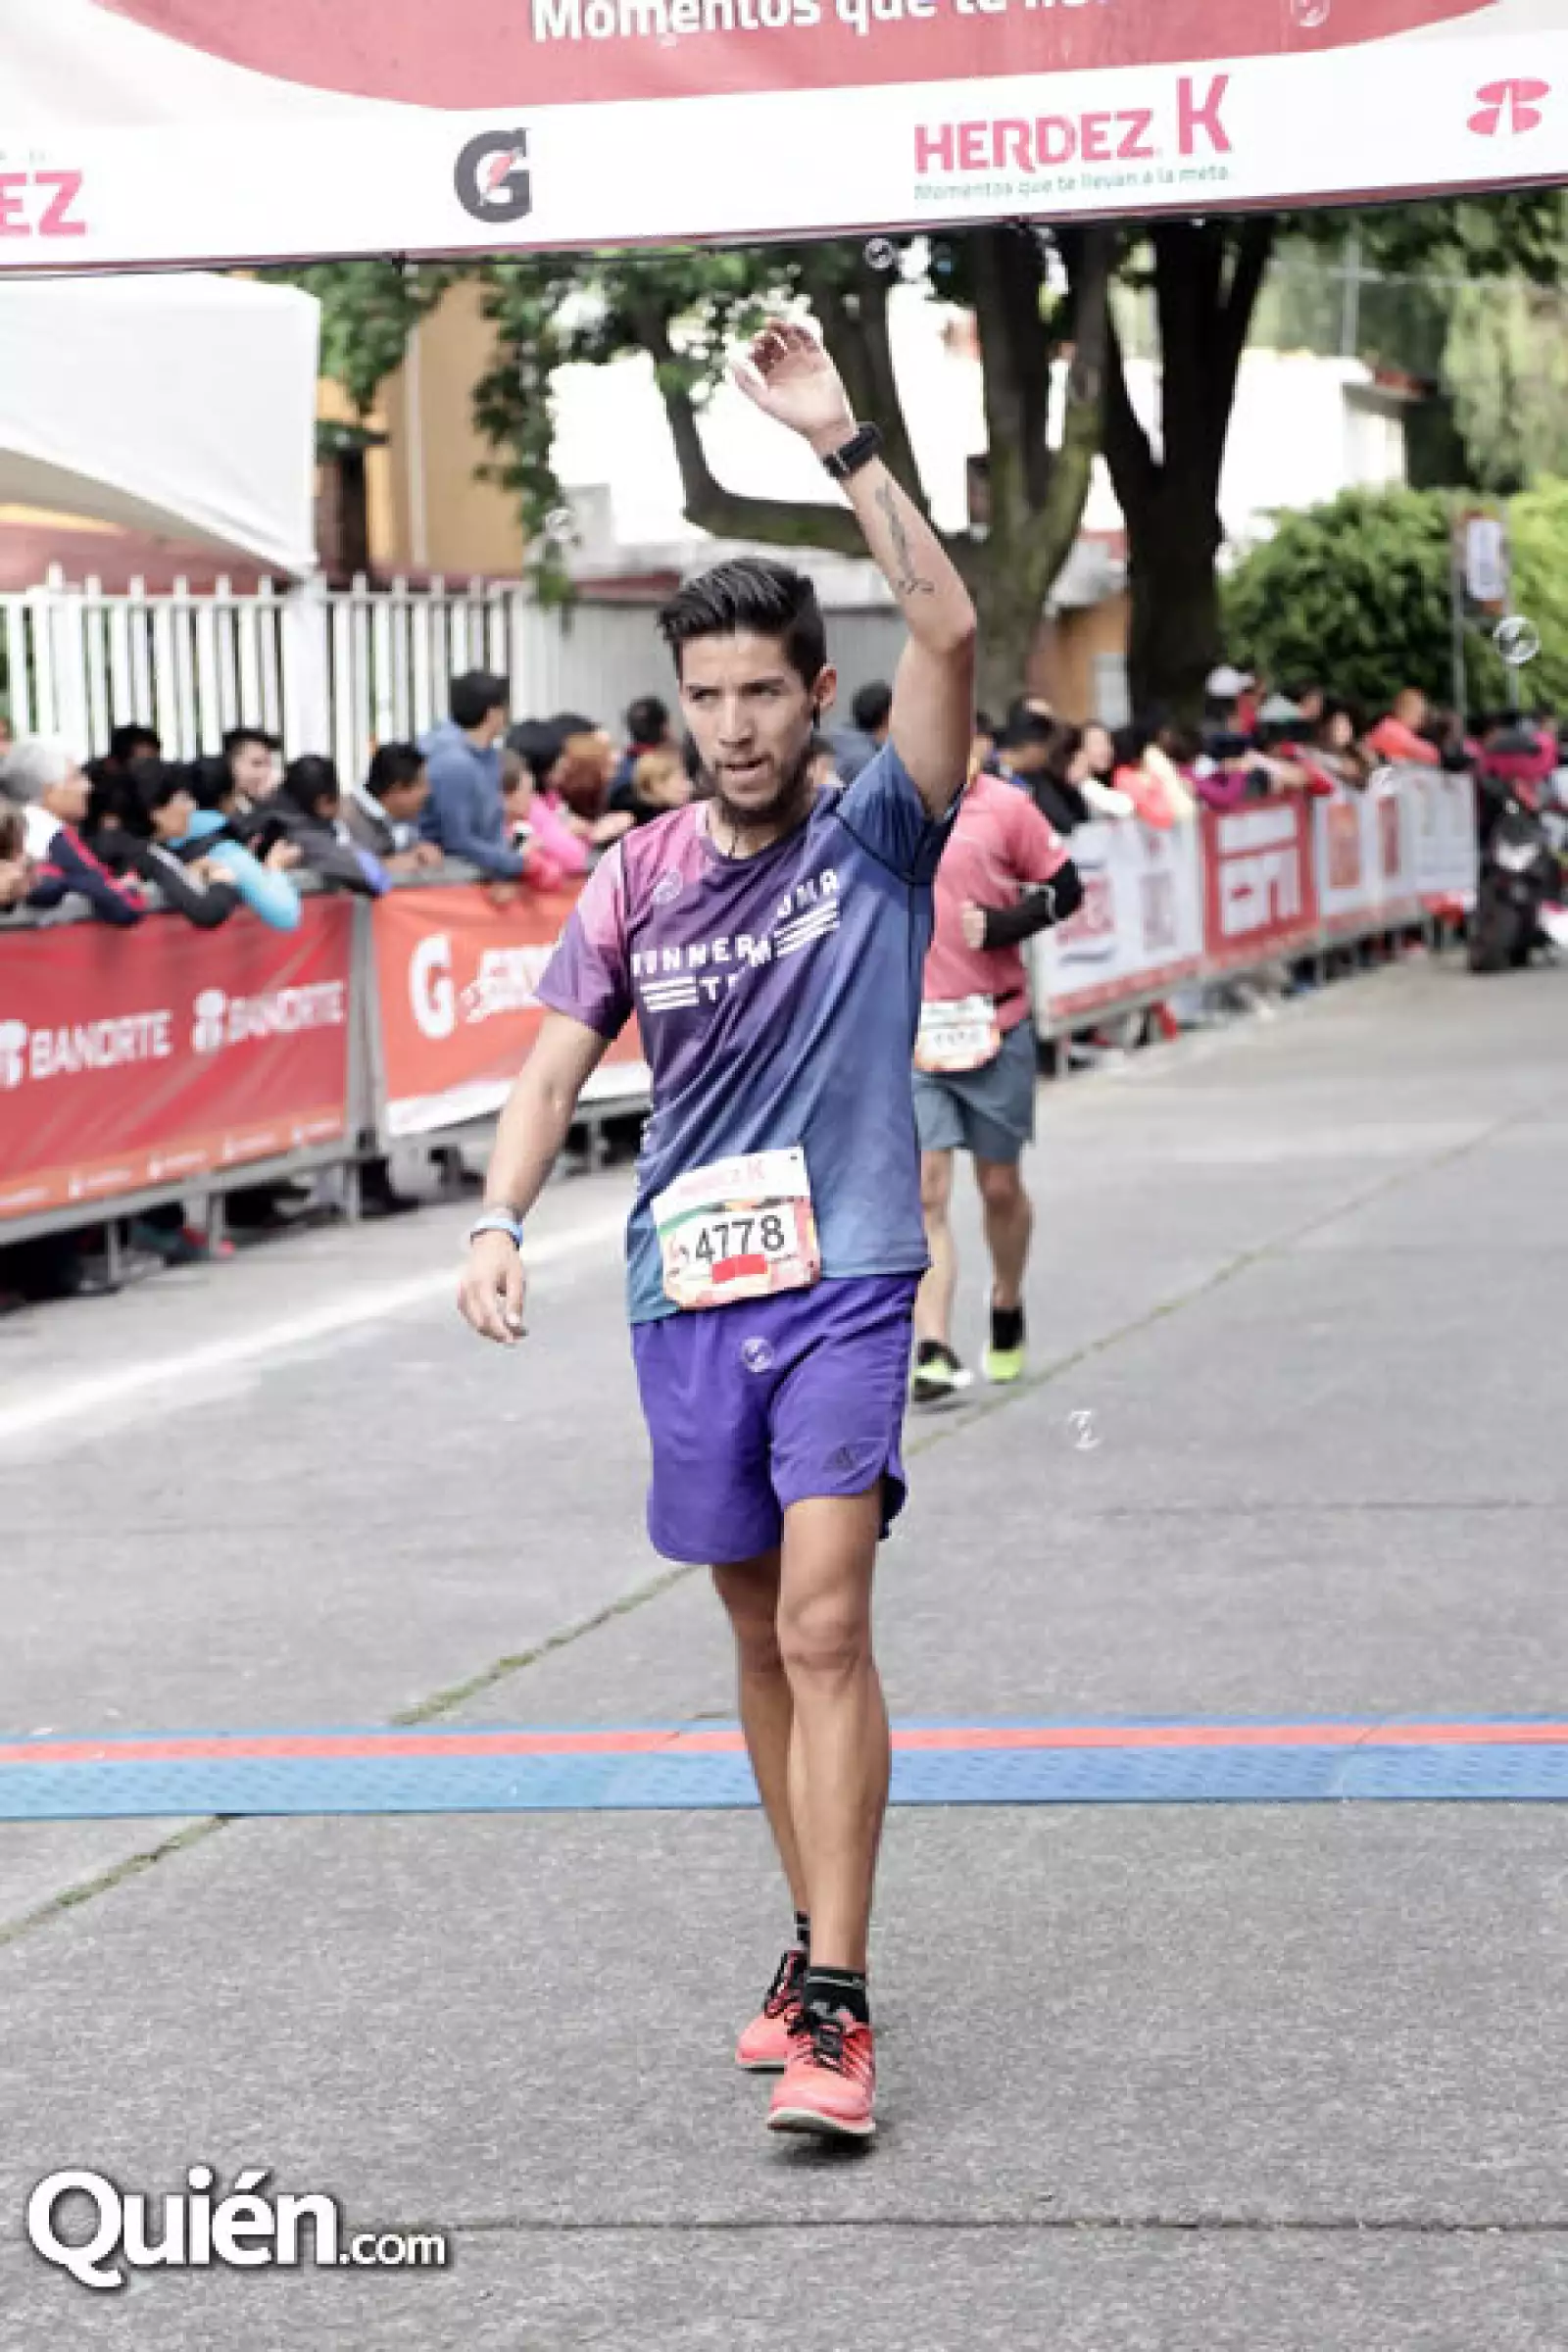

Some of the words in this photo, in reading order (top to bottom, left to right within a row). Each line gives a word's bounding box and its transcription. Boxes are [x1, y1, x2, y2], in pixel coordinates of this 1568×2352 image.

[535, 0, 820, 42] Momentos
[913, 108, 1154, 173] HERDEZ
[1176, 74, 1232, 155] K
[0, 171, 86, 236] EZ
[454, 127, 531, 223] G
[30, 1009, 172, 1079] BANORTE
[696, 1214, 785, 1265] 4778
